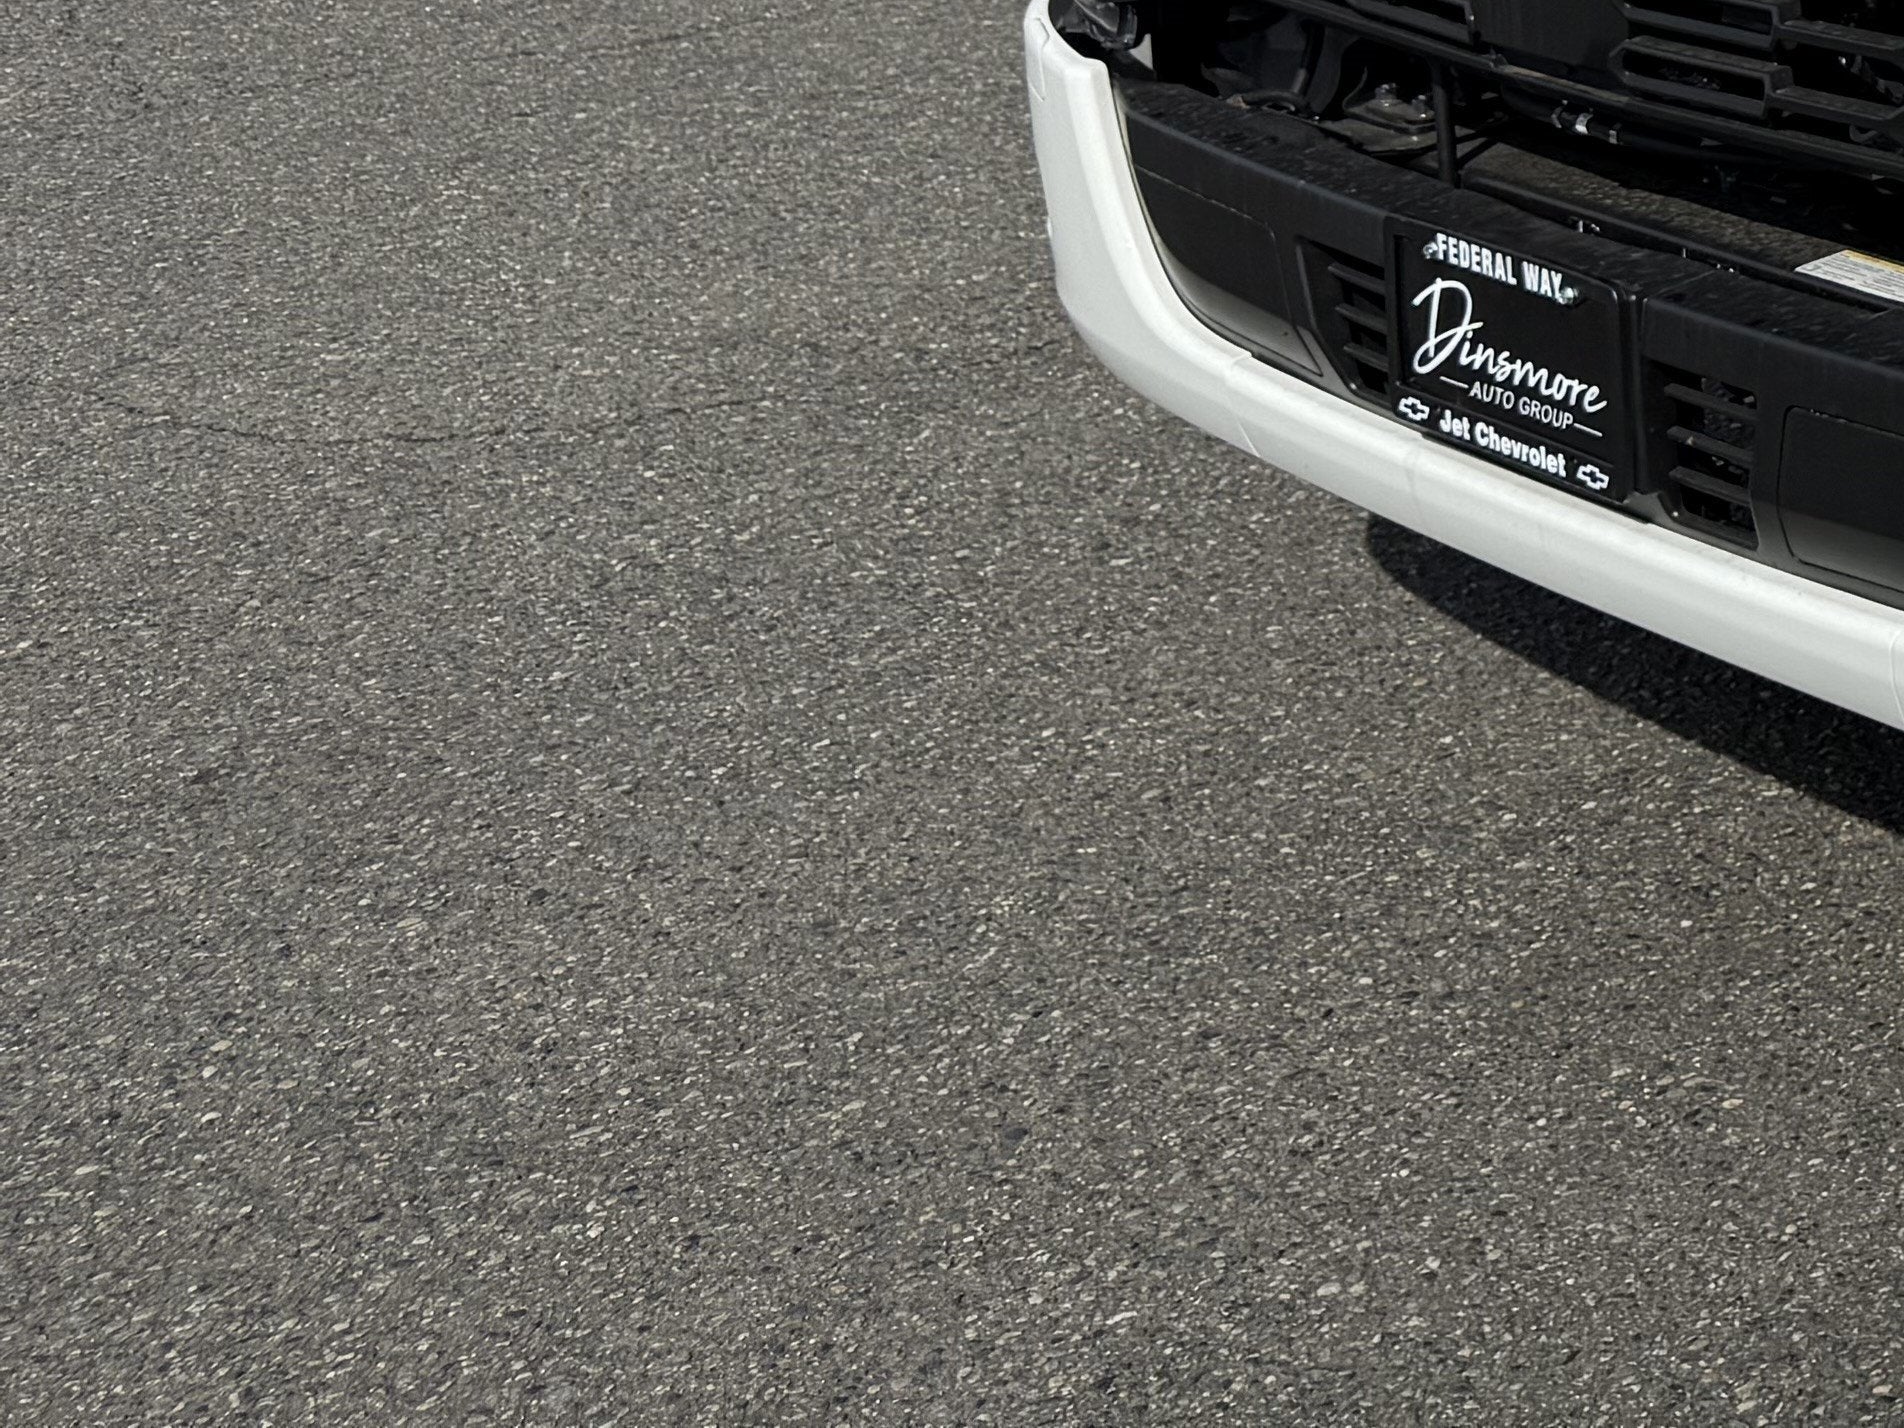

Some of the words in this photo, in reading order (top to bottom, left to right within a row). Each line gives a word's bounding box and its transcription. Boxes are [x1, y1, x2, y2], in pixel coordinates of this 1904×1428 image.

[1435, 232, 1517, 285] FEDERAL
[1522, 260, 1563, 300] WAY
[1411, 277, 1608, 413] Dinsmore
[1469, 380, 1515, 410] AUTO
[1518, 396, 1574, 430] GROUP
[1439, 408, 1471, 441] Jet
[1474, 420, 1567, 478] Chevrolet
